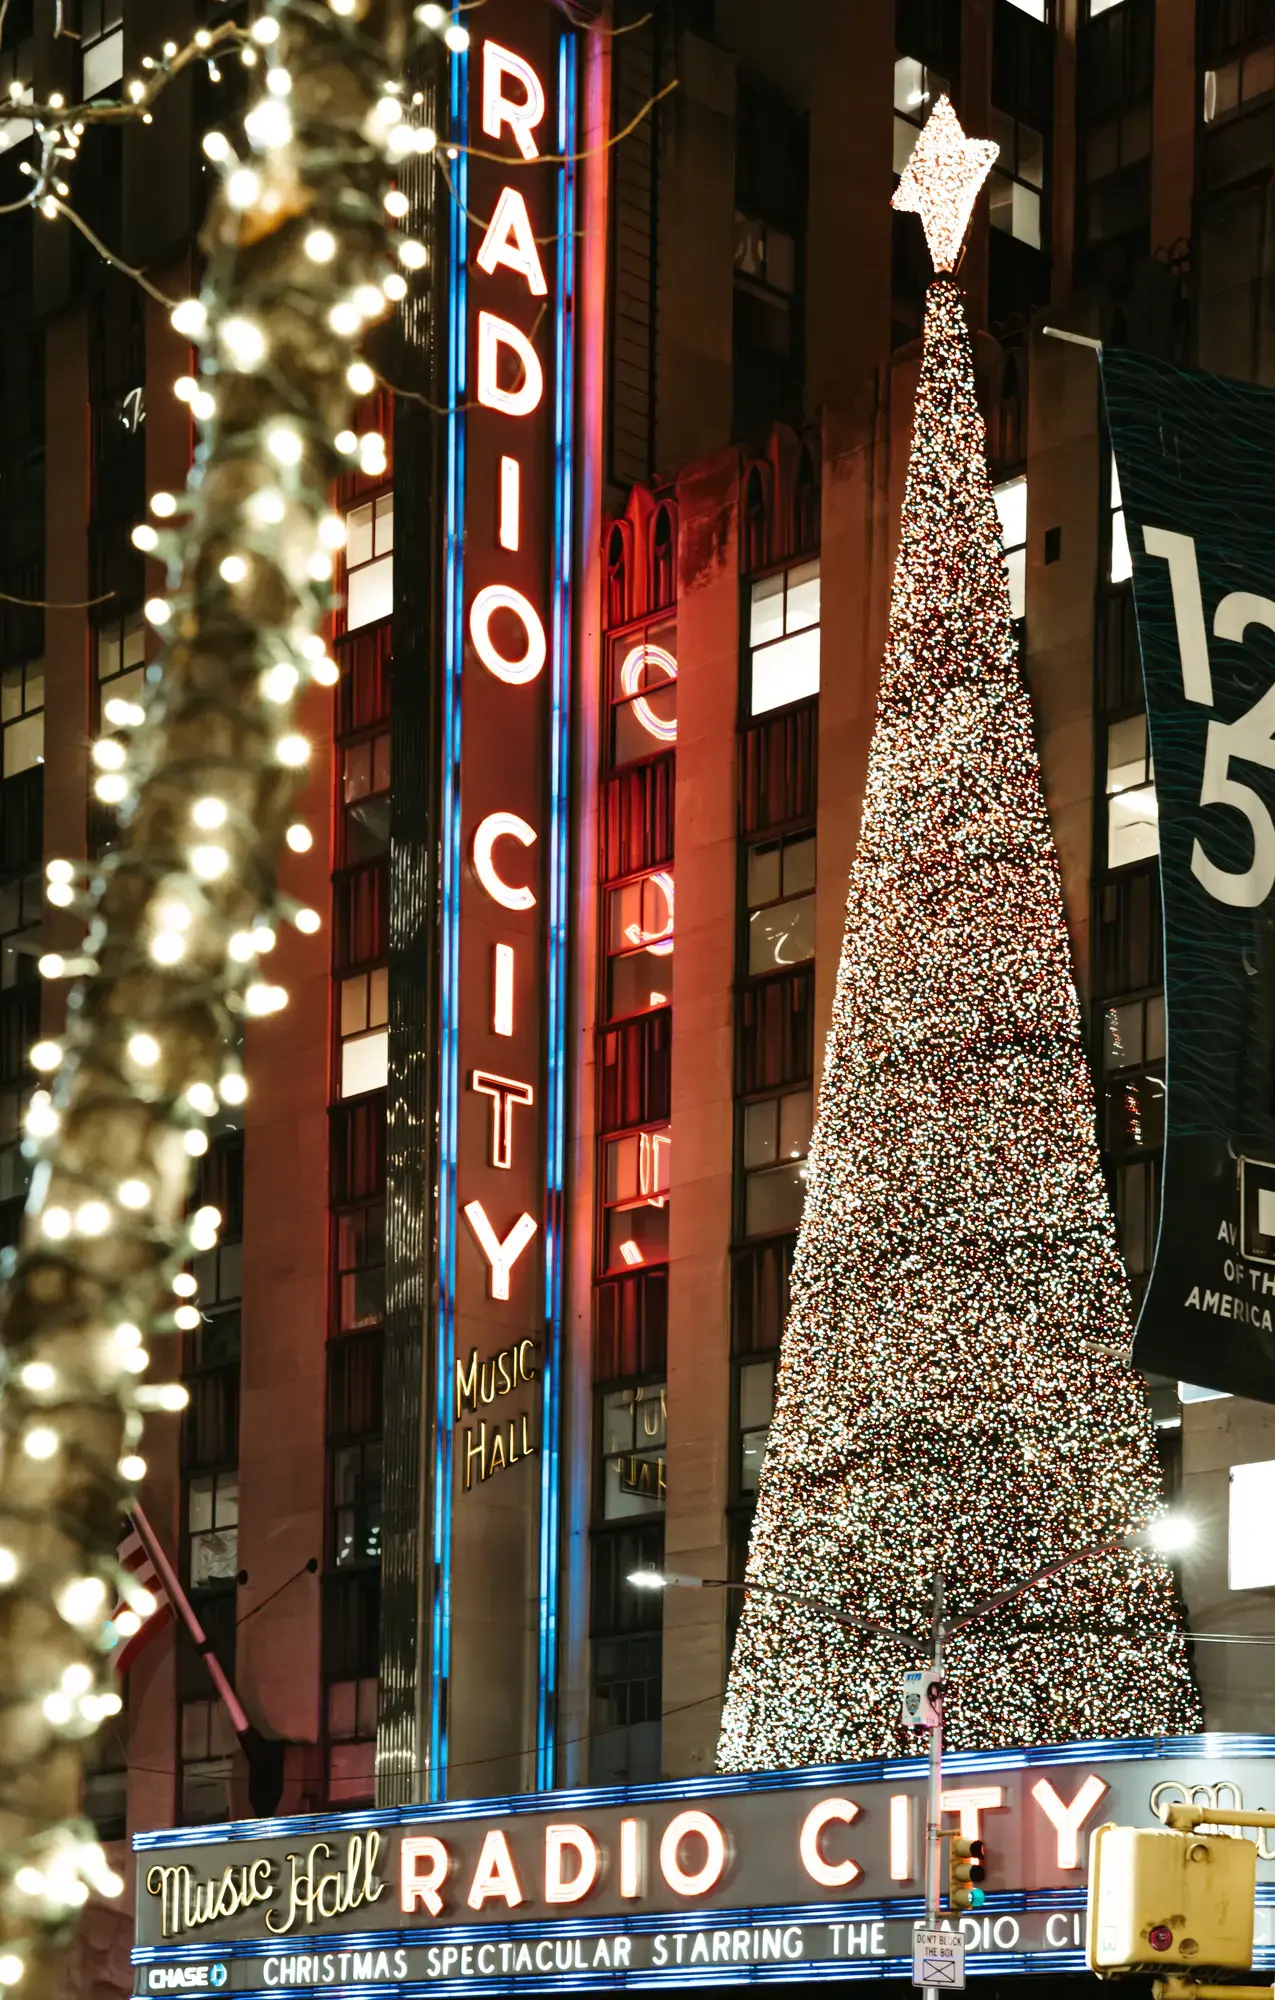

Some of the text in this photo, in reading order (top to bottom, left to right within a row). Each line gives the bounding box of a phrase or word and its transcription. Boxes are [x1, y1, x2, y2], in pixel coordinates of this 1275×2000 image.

[463, 38, 548, 1301] RADIO CITY
[1223, 1259, 1244, 1284] OF
[401, 1810, 726, 1917] RADIO
[800, 1774, 1109, 1887] CITY
[147, 1829, 387, 1937] Music Hall
[263, 1913, 1087, 1985] CHRISTMAS SPECTACULAR STARRING THE DIO CI
[917, 1934, 962, 1946] DON'T BLOCK
[925, 1946, 954, 1958] THE BOX
[149, 1966, 209, 1989] CHASE
